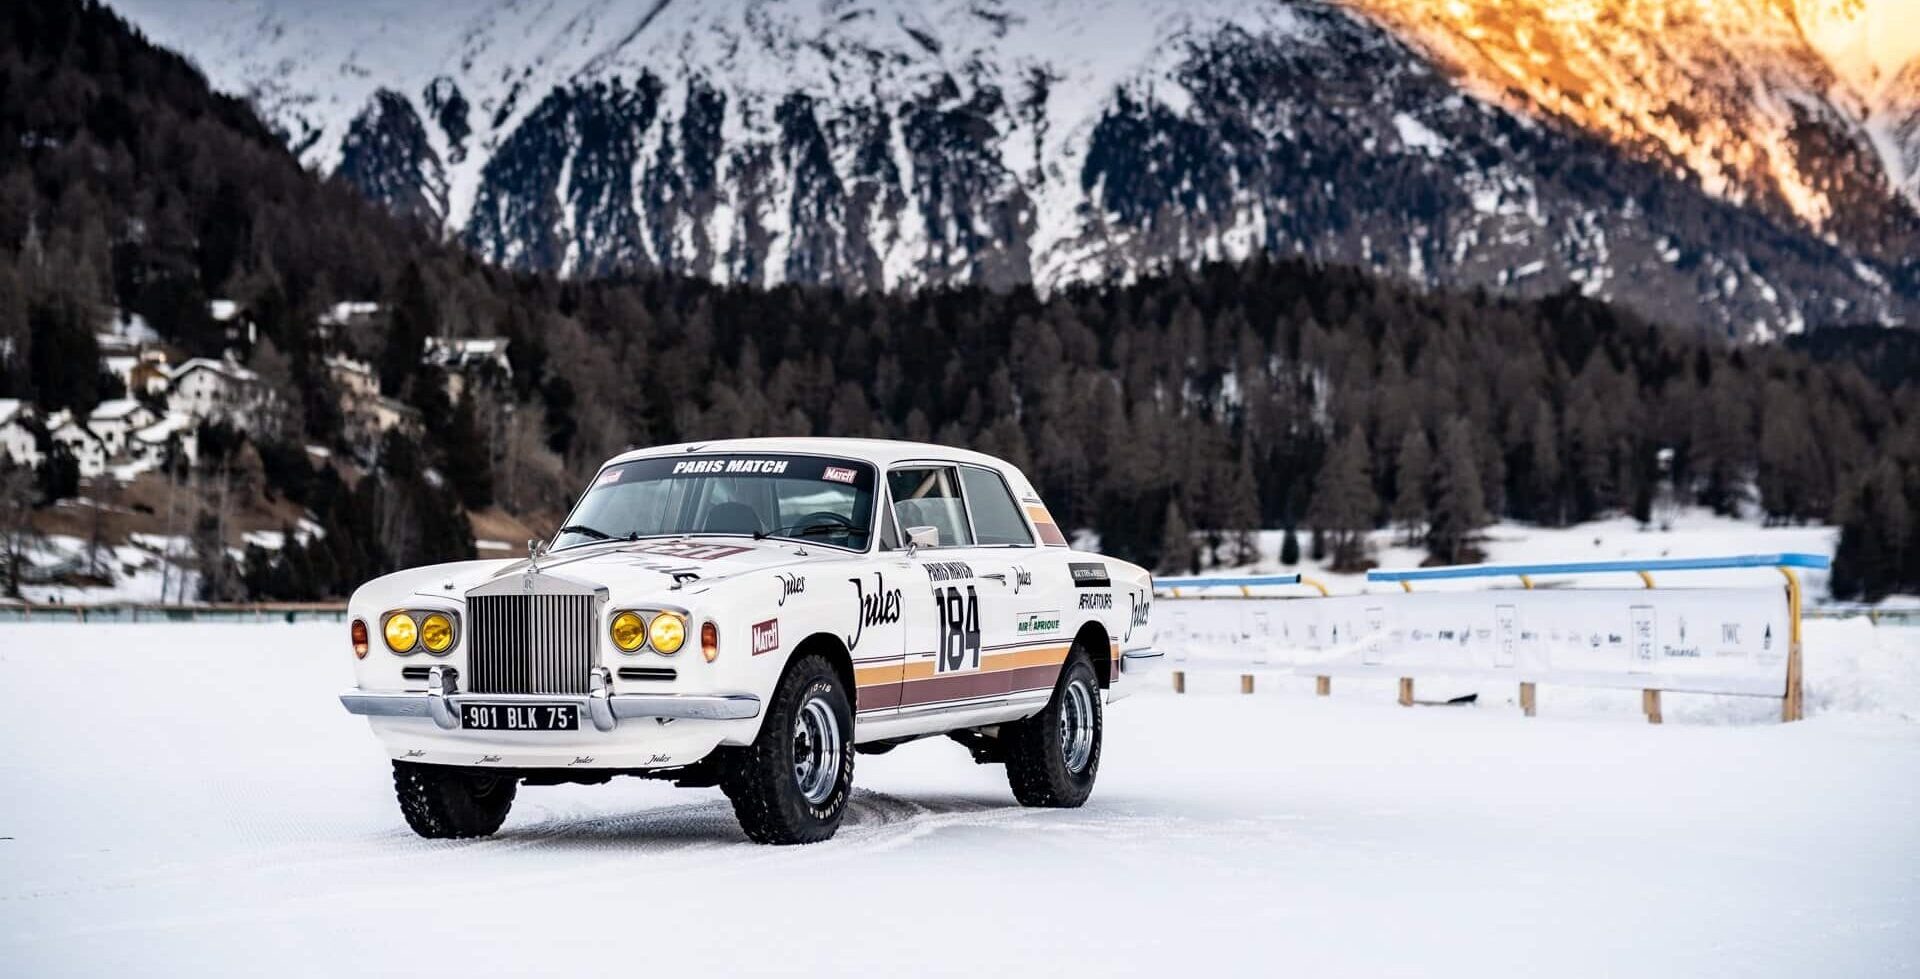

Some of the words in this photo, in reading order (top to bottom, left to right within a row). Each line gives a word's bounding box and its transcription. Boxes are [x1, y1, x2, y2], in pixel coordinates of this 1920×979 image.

[672, 460, 725, 474] PARIS
[728, 460, 789, 474] MATCH
[921, 562, 950, 581] PARIS
[943, 561, 974, 580] MATCH
[1011, 566, 1032, 595] Jules
[774, 572, 805, 607] Jules
[848, 571, 903, 652] Jules
[1125, 588, 1150, 643] Jules
[934, 584, 982, 673] 184
[470, 706, 499, 728] 901
[507, 707, 538, 728] BLK
[547, 707, 569, 728] 75
